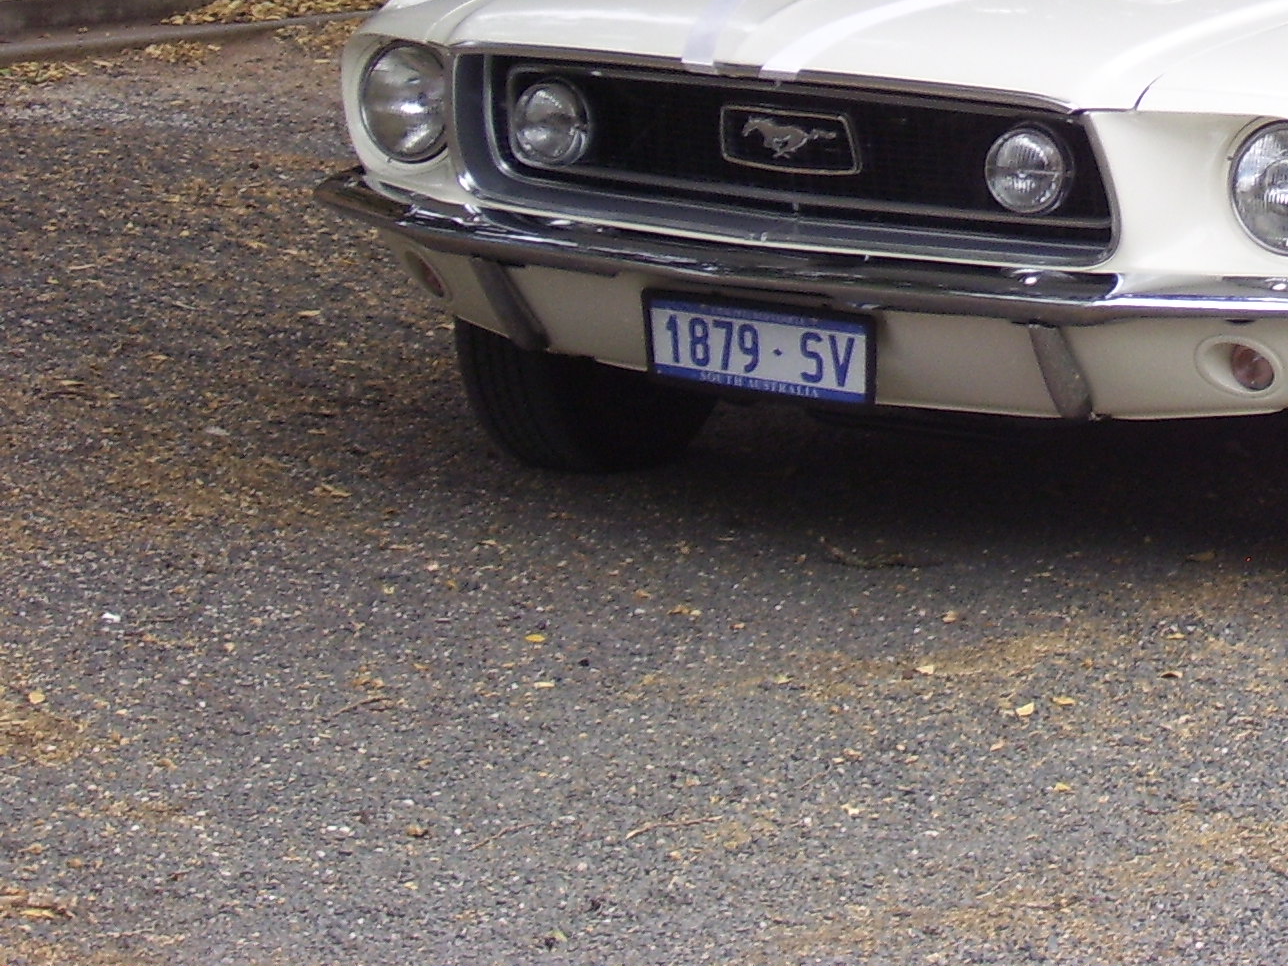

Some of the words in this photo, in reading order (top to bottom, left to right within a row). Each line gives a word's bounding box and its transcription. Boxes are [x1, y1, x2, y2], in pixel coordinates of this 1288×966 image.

[665, 314, 760, 374] 1879
[800, 331, 855, 387] SV
[699, 371, 742, 387] SOUTH
[748, 378, 819, 398] AUSTRALIA
